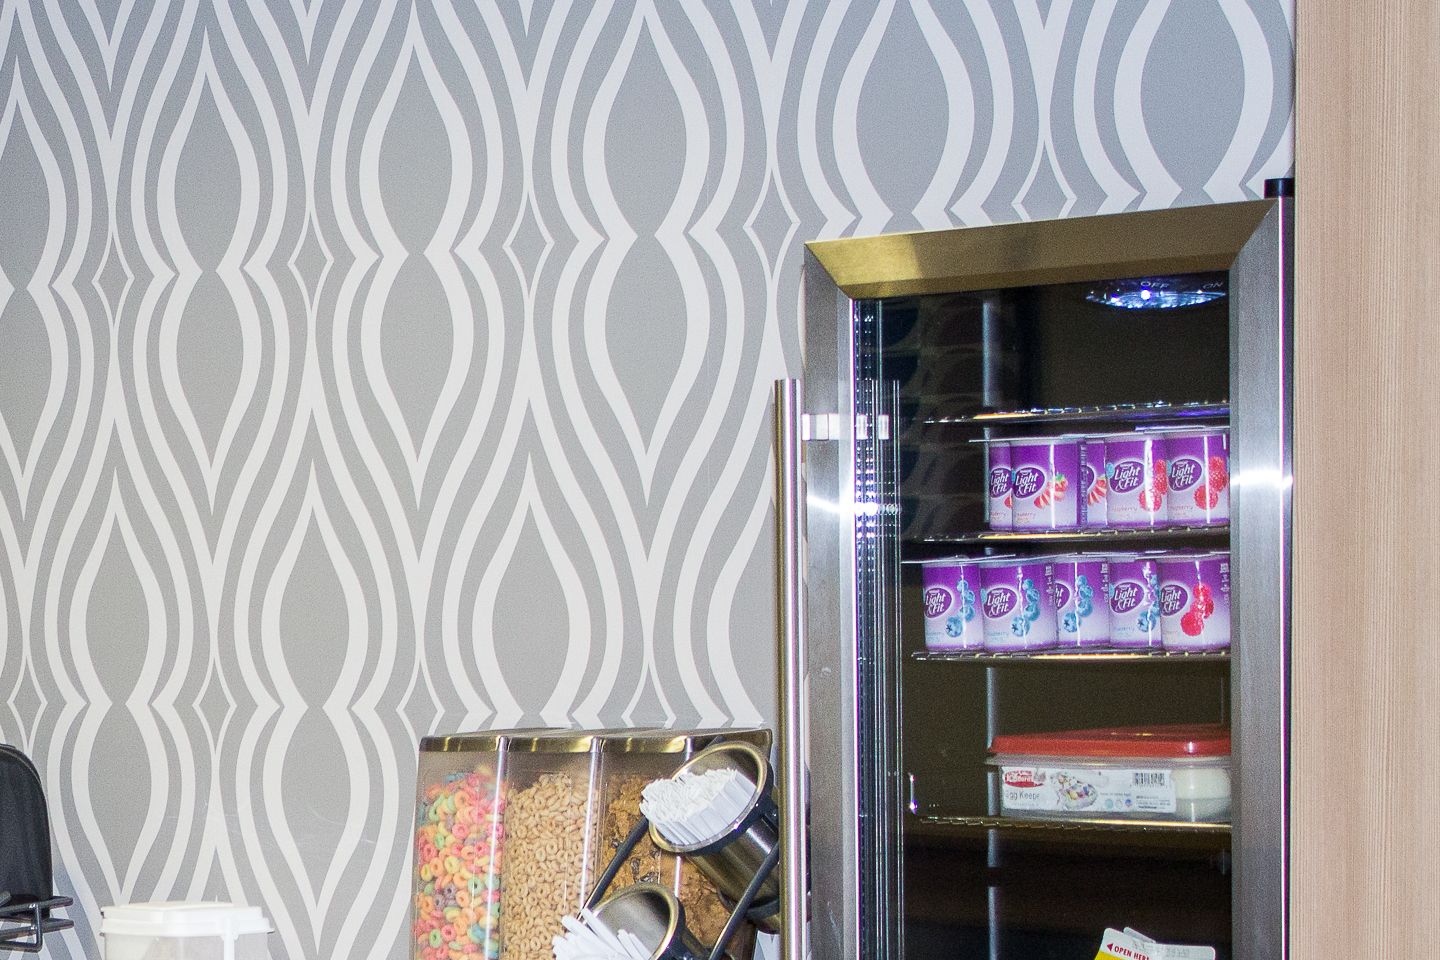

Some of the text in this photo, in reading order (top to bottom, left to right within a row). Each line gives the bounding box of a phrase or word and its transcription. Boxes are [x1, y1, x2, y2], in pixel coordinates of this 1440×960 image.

[1140, 281, 1169, 289] OFF
[1203, 281, 1223, 289] ON
[1115, 466, 1140, 480] Light
[1172, 464, 1195, 478] Light
[1016, 473, 1038, 486] Light
[926, 593, 946, 606] Light
[988, 592, 1011, 606] Light
[1115, 588, 1138, 601] Light
[1115, 946, 1131, 957] OPEN
